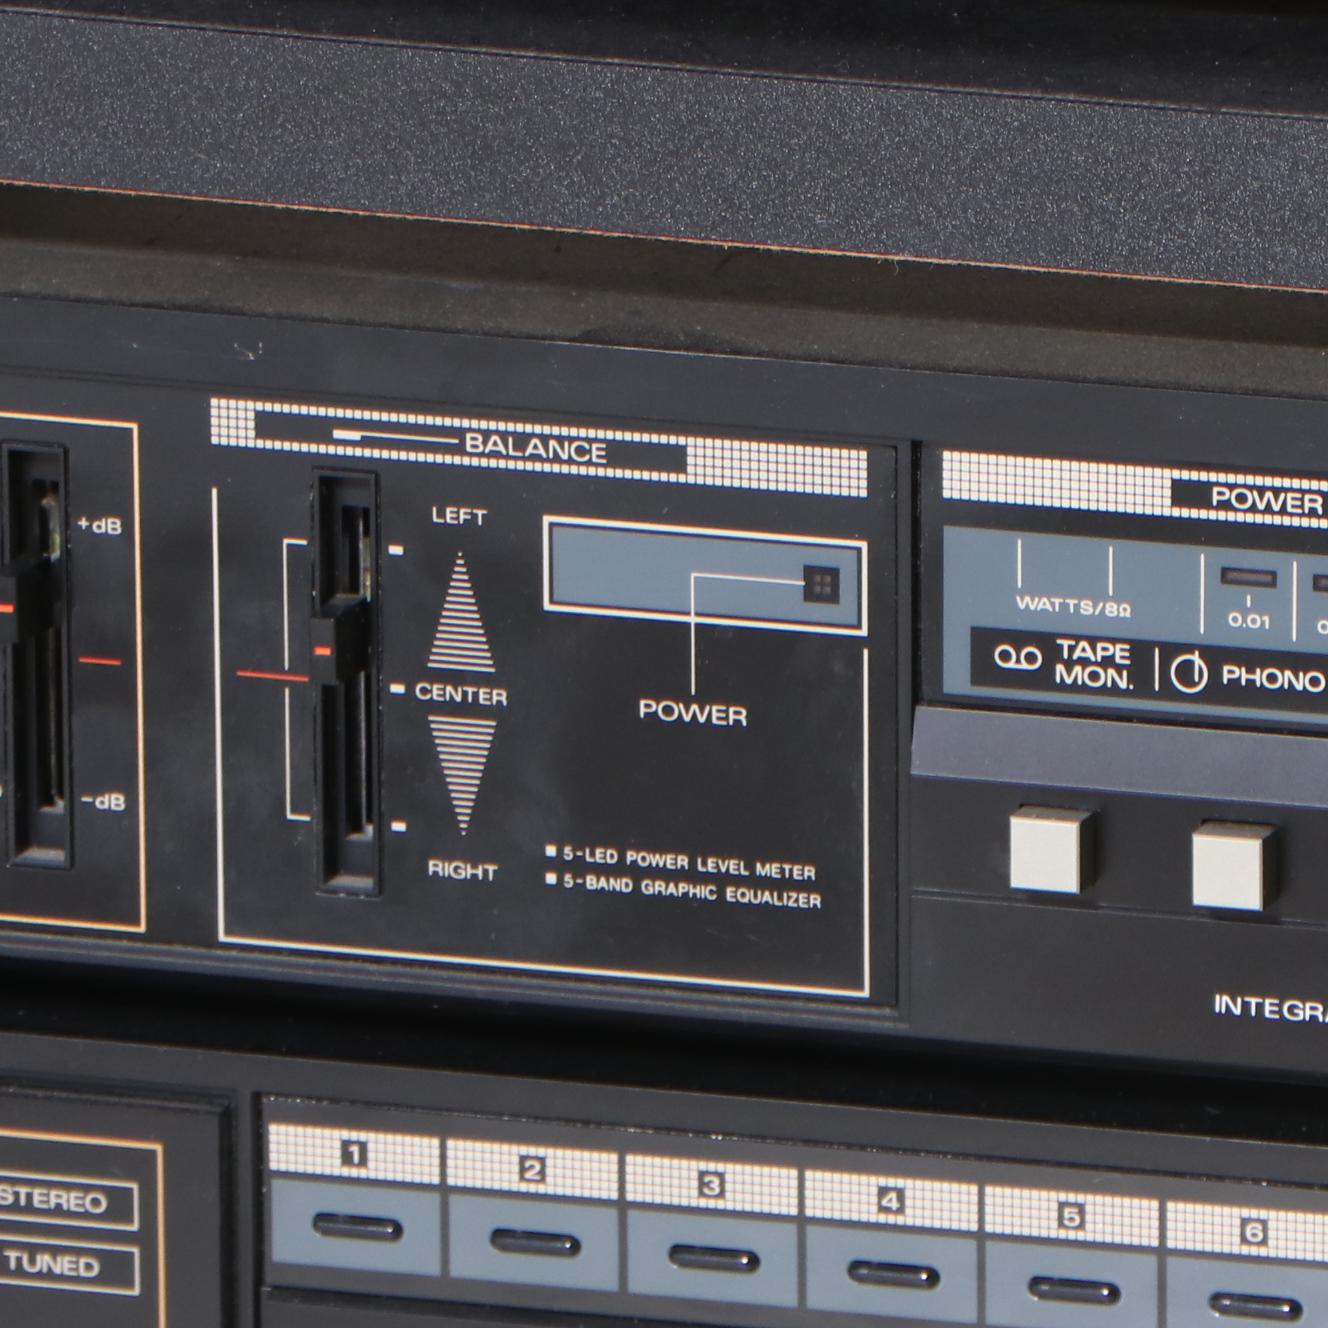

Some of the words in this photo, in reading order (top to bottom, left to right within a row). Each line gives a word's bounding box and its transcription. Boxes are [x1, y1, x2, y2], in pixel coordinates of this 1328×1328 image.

[465, 433, 608, 465] BALANCE
[1212, 486, 1323, 515] POWER
[78, 515, 123, 536] +dB
[432, 506, 487, 526] LEFT
[1228, 612, 1270, 630] 0.01
[1057, 640, 1131, 665] TAPE
[1055, 664, 1134, 691] MON.
[1222, 665, 1326, 692] PHONO
[415, 682, 508, 707] CENTER
[640, 700, 748, 728] POWER
[428, 861, 498, 883] RIGHT
[563, 846, 618, 865] 5-LED
[627, 851, 689, 871] POWER
[697, 856, 748, 875] LEVEL
[755, 862, 816, 881] METER
[563, 873, 633, 893] 5-BAND
[640, 879, 718, 901] GRAPHIC
[726, 886, 821, 909] EQUALIZER
[348, 1144, 362, 1164] 1
[523, 1161, 541, 1179] 2
[703, 1177, 721, 1195] 3
[880, 1192, 900, 1210] 4
[1063, 1208, 1081, 1226] 5
[1245, 1224, 1263, 1242] 6
[3, 1249, 100, 1279] TUNED
